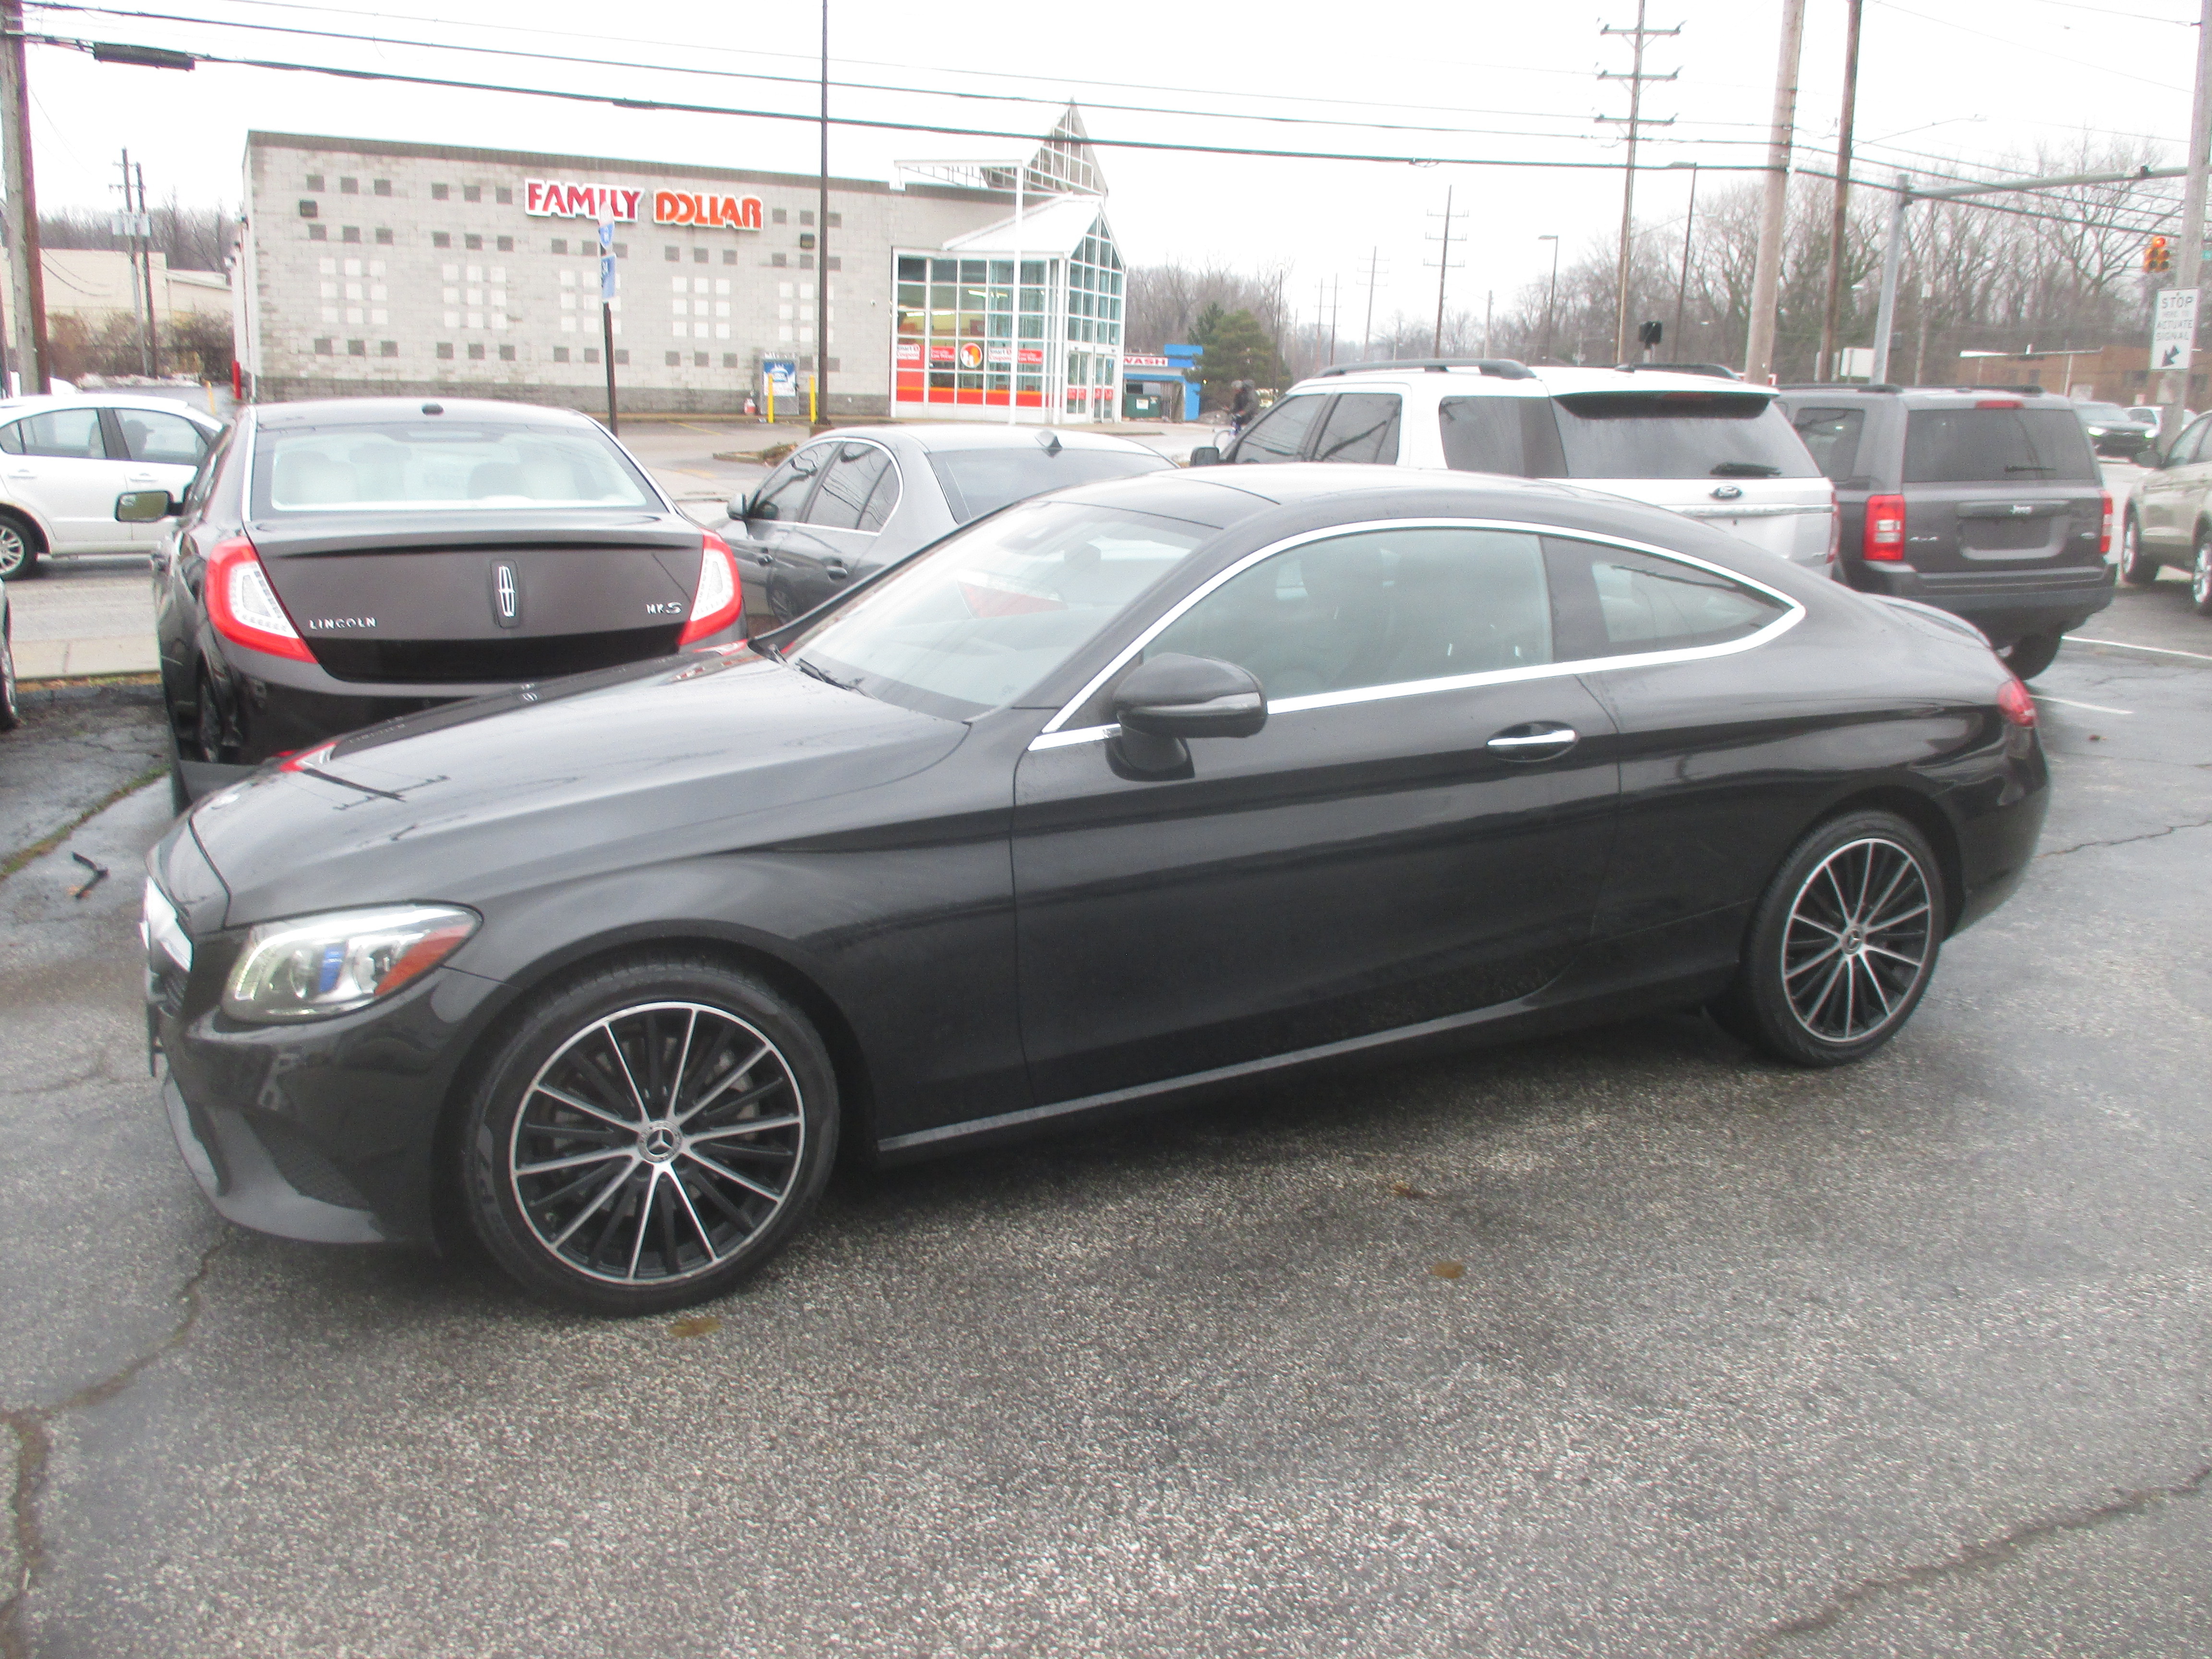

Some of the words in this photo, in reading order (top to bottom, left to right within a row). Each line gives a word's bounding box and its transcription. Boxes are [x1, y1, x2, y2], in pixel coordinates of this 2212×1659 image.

[528, 183, 641, 219] FAMILY
[656, 191, 762, 229] DOLLAR
[2161, 296, 2194, 309] STOP
[646, 601, 682, 614] MKS
[308, 616, 377, 630] LINCOLN
